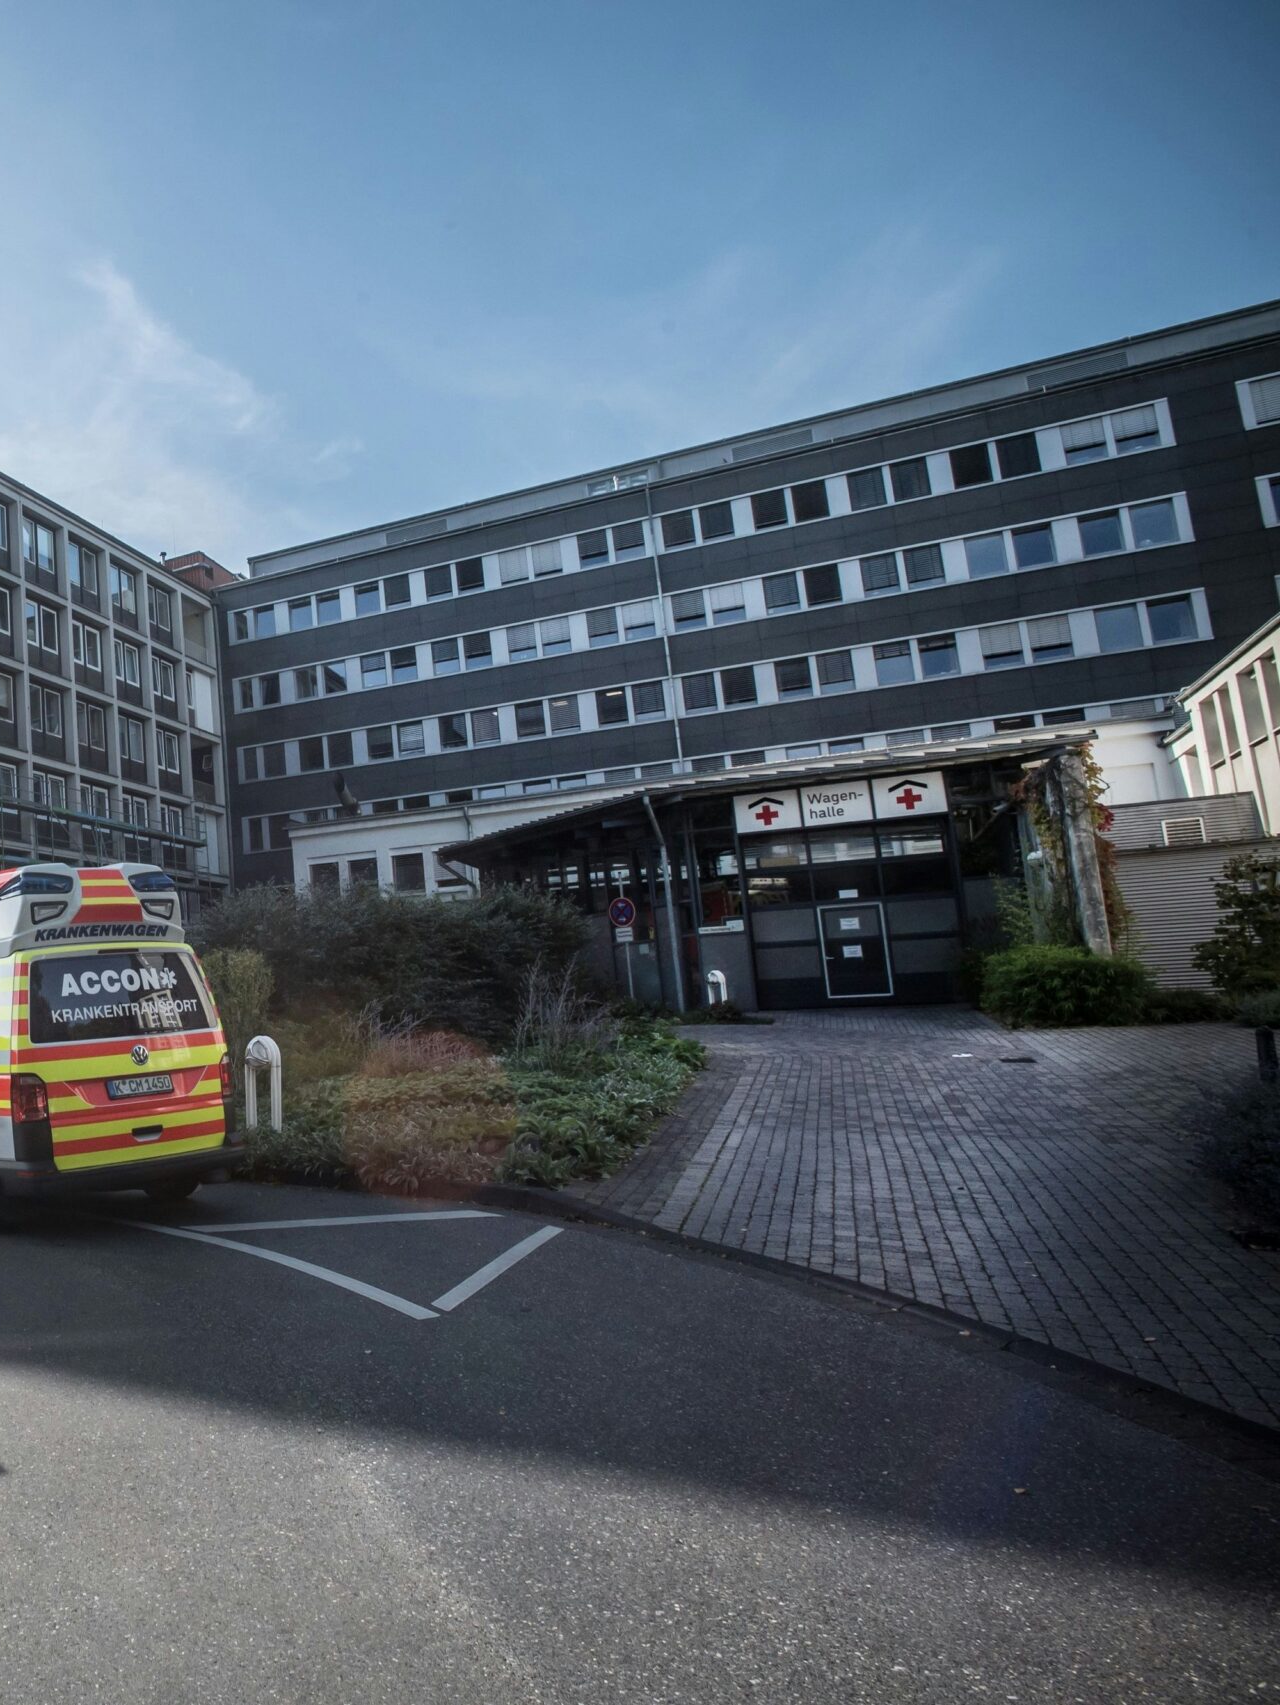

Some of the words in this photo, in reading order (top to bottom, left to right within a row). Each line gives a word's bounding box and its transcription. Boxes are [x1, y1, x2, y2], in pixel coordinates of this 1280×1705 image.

[806, 791, 864, 806] Wagen-
[809, 806, 845, 820] halle
[34, 923, 170, 943] KRANKENWAGEN
[51, 998, 199, 1024] KRANKENTRANSPORT
